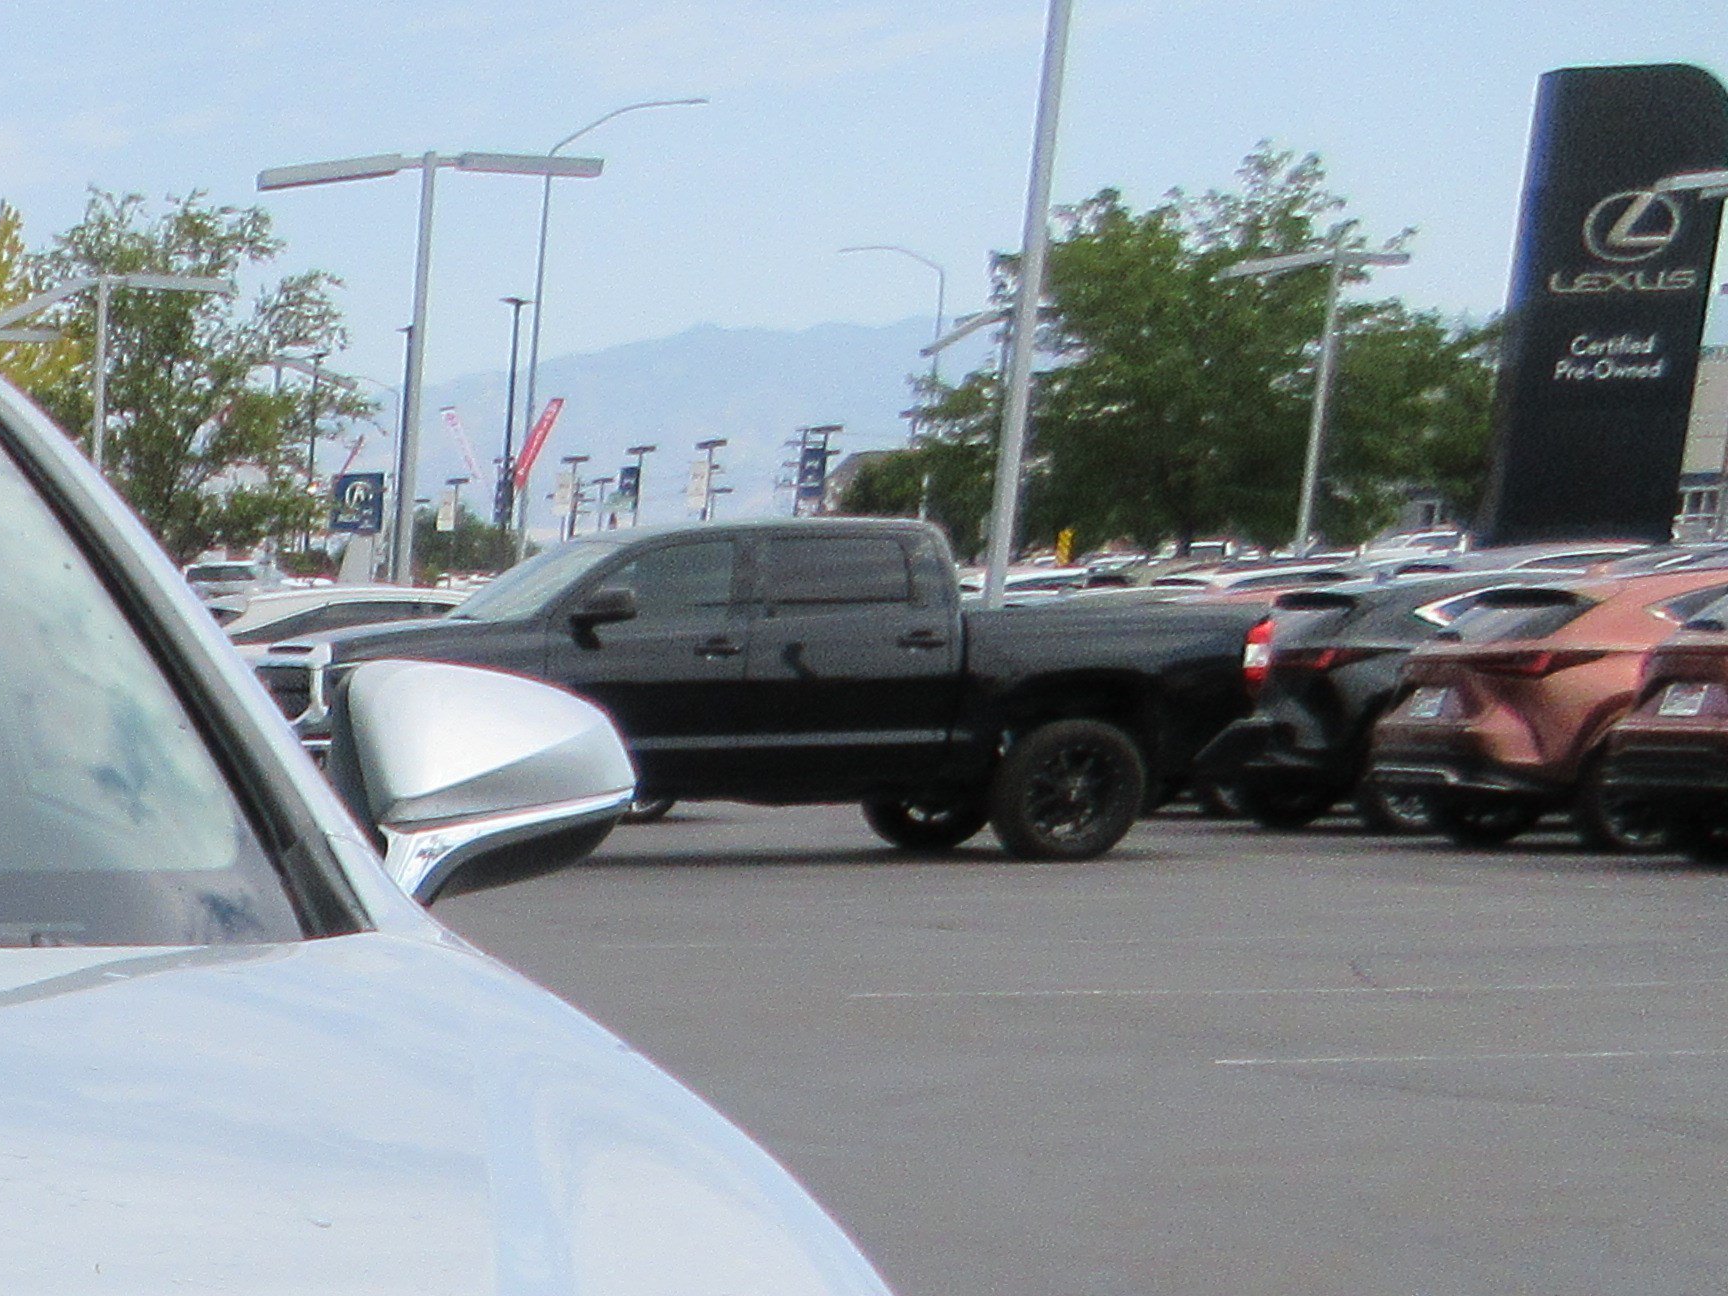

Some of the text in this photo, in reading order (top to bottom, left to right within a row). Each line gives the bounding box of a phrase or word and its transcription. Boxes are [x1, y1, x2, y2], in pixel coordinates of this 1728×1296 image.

[1550, 269, 1697, 294] LEXUS
[1571, 332, 1656, 355] Certified
[1554, 358, 1665, 381] Pre-Owned
